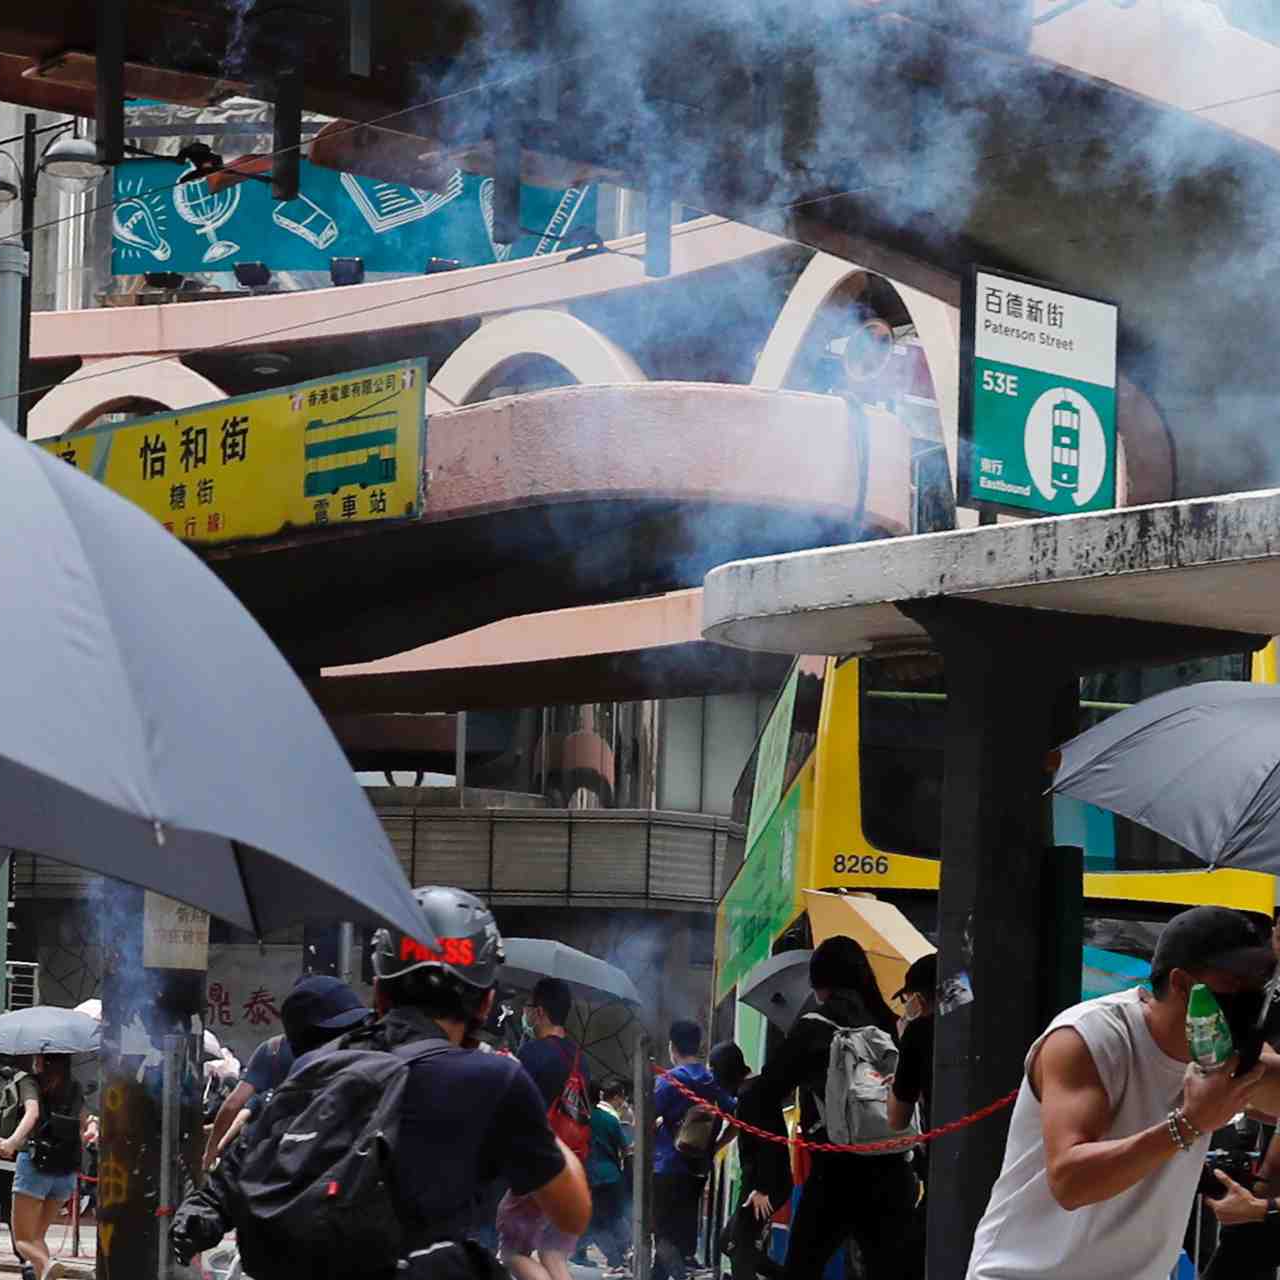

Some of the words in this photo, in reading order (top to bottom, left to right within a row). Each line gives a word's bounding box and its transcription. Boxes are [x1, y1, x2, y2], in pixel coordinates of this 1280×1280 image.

[984, 286, 1064, 329] 百德新街
[984, 319, 1036, 345] Paterson
[1039, 332, 1074, 352] Street
[308, 374, 396, 406] 香港電車有限公司
[982, 370, 1018, 397] 53E
[139, 415, 249, 480] 怡和街
[169, 478, 214, 510] 糖街
[313, 488, 388, 523] 電車站
[833, 853, 889, 875] 8266
